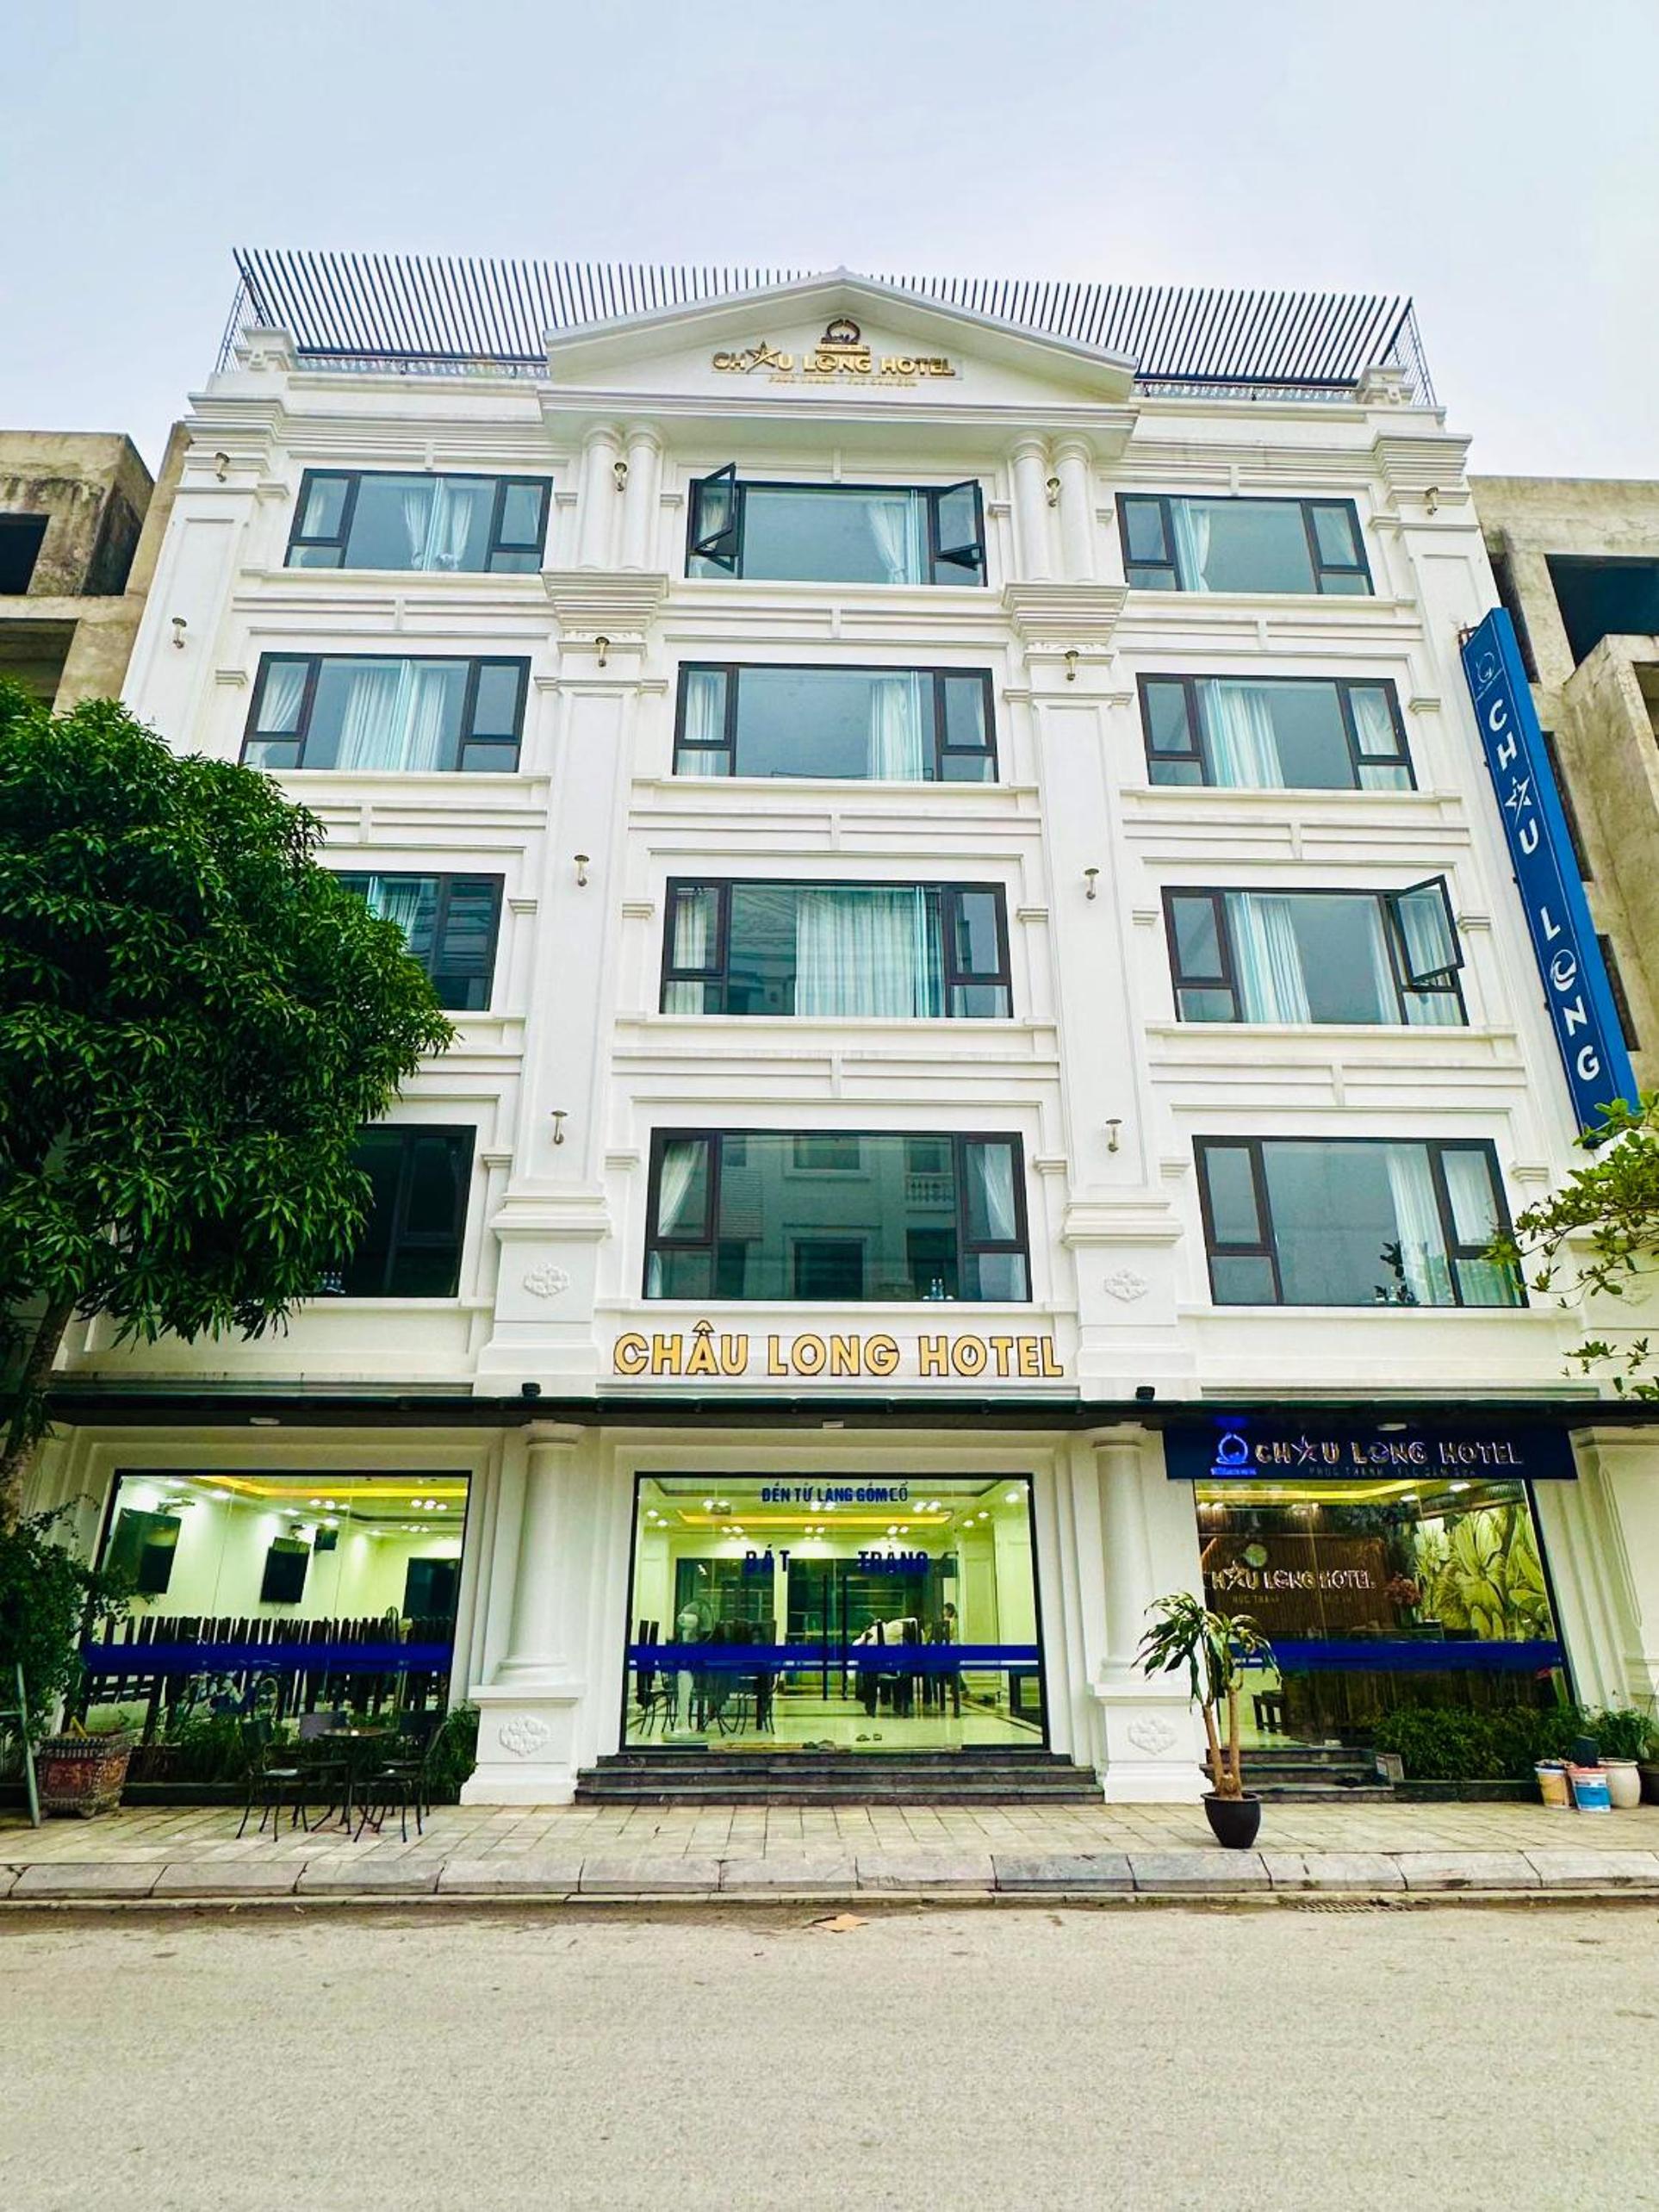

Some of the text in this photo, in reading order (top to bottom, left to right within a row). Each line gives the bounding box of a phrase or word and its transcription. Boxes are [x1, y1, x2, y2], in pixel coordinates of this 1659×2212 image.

[804, 354, 871, 374] LONG
[880, 357, 955, 376] HOTEL
[612, 1320, 1064, 1377] CHÂU LONG HOTEL
[1351, 1442, 1428, 1464] LONG
[1438, 1442, 1524, 1464] HOTEL
